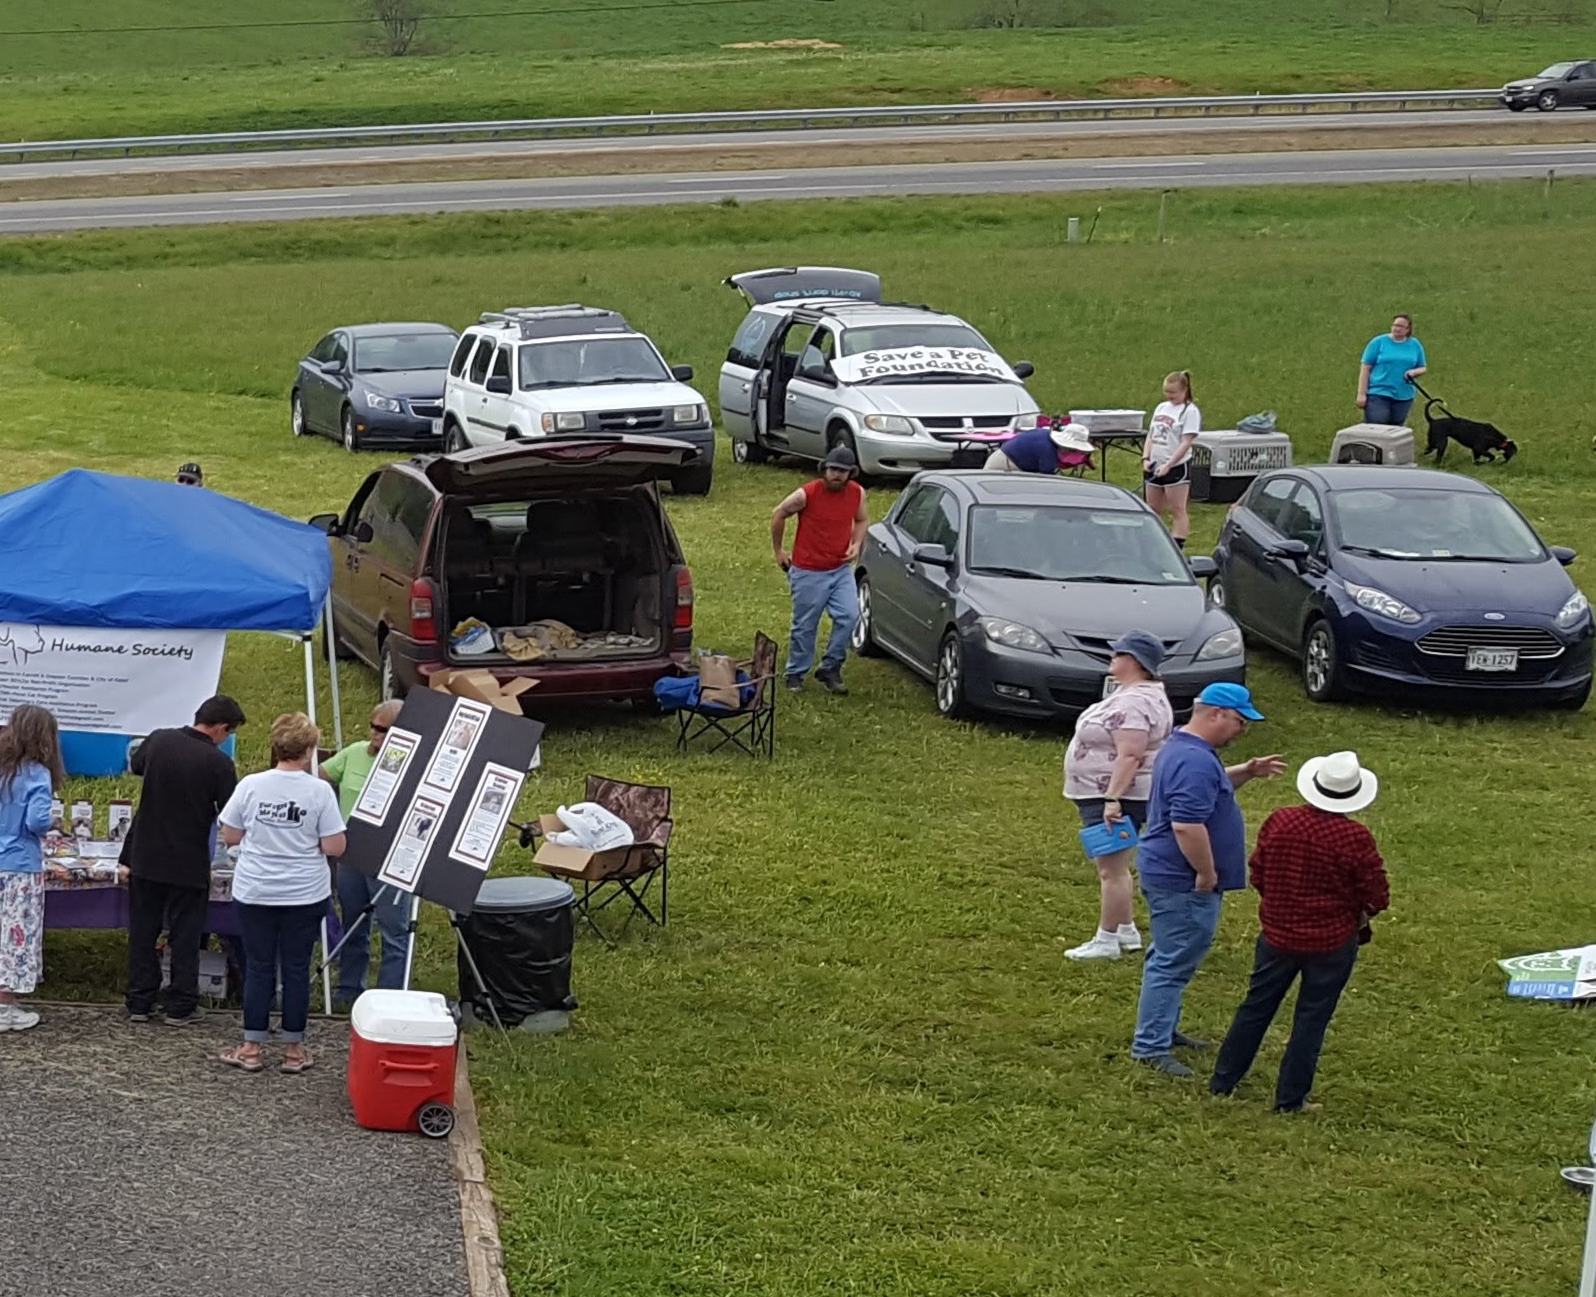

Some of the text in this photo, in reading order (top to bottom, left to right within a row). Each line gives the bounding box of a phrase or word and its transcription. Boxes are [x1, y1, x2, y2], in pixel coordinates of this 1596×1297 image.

[863, 349, 989, 364] Save a Pet
[859, 360, 1004, 378] Foundation
[51, 637, 129, 654] Humane
[131, 643, 194, 661] Society
